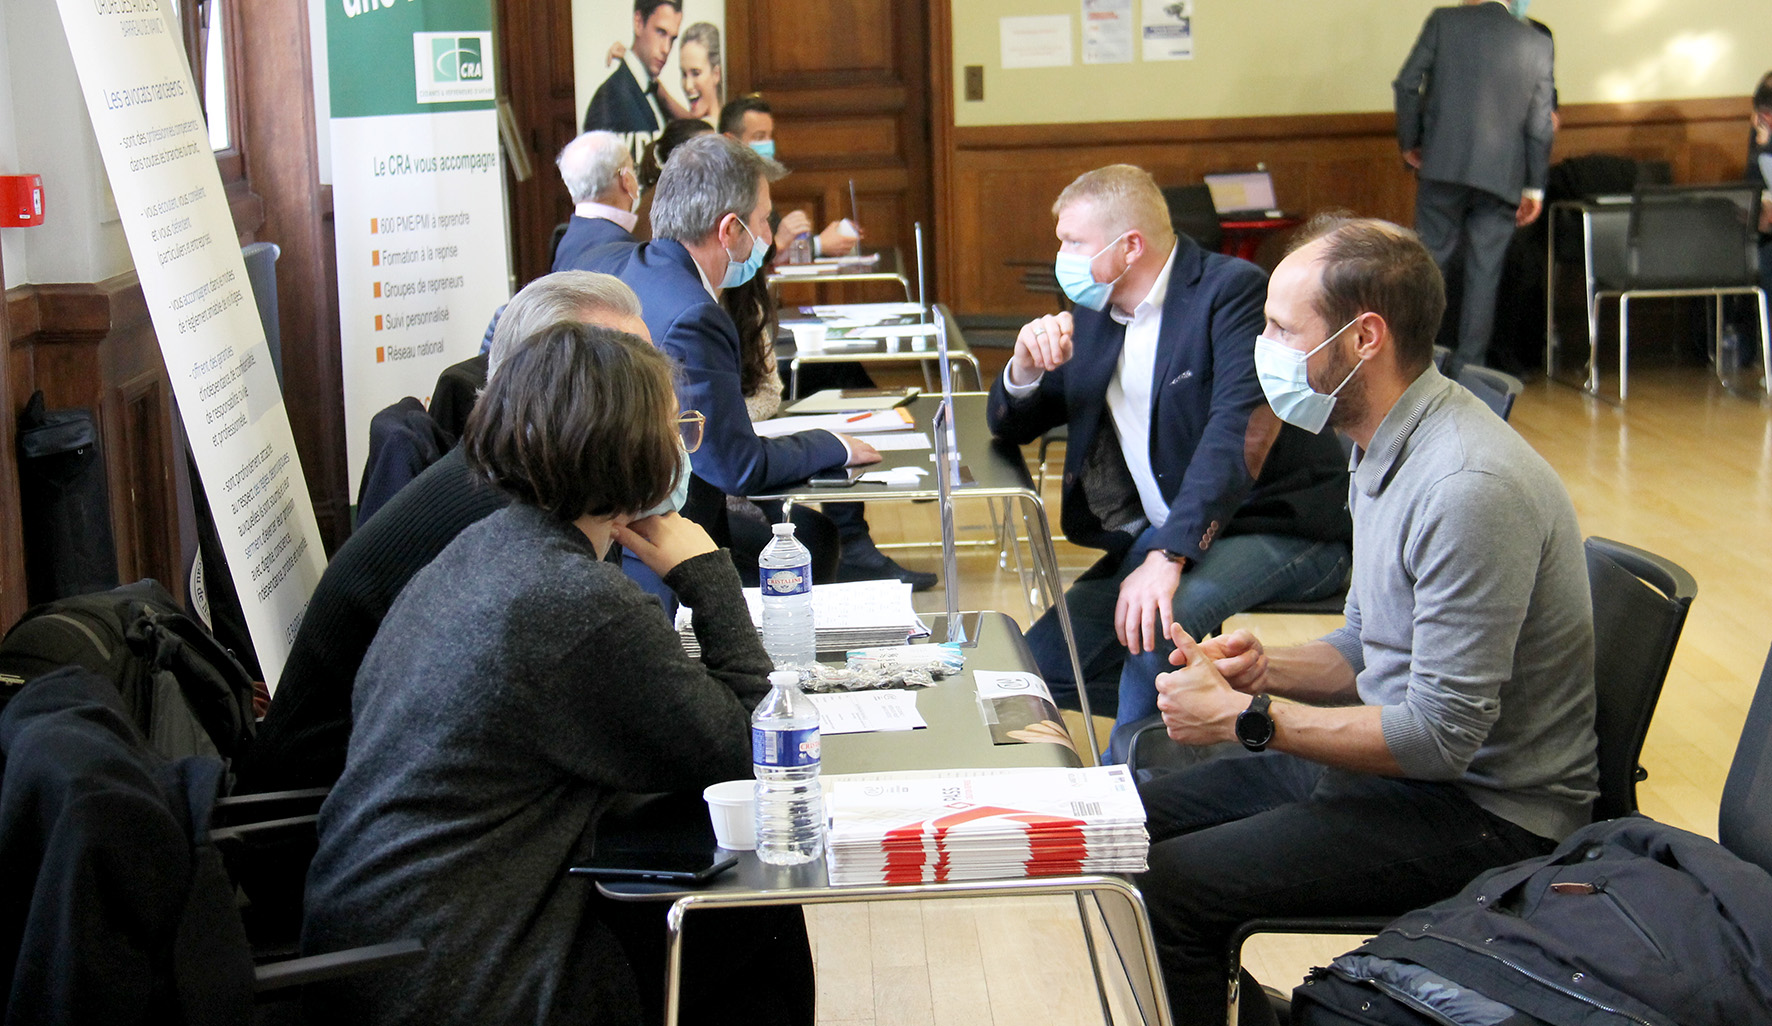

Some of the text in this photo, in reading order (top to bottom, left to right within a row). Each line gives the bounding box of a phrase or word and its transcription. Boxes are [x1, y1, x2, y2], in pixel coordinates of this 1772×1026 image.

[460, 62, 482, 78] CRA
[103, 89, 124, 110] Les
[123, 85, 153, 106] avocats
[123, 135, 138, 149] sont
[130, 156, 145, 172] dans
[373, 152, 496, 177] Le CRA vous accompagne
[144, 203, 159, 219] vous
[380, 217, 395, 234] 600
[438, 210, 470, 231] reprendre
[151, 229, 159, 242] et
[159, 225, 172, 240] vous
[382, 248, 419, 266] Formation
[434, 244, 458, 263] reprise
[383, 275, 464, 300] Groupes de repreneurs
[385, 305, 450, 330] Suivi personnalisé
[387, 339, 444, 361] Réseau national
[205, 410, 214, 425] de
[212, 434, 220, 447] et
[225, 475, 237, 493] sont
[231, 501, 240, 516] au
